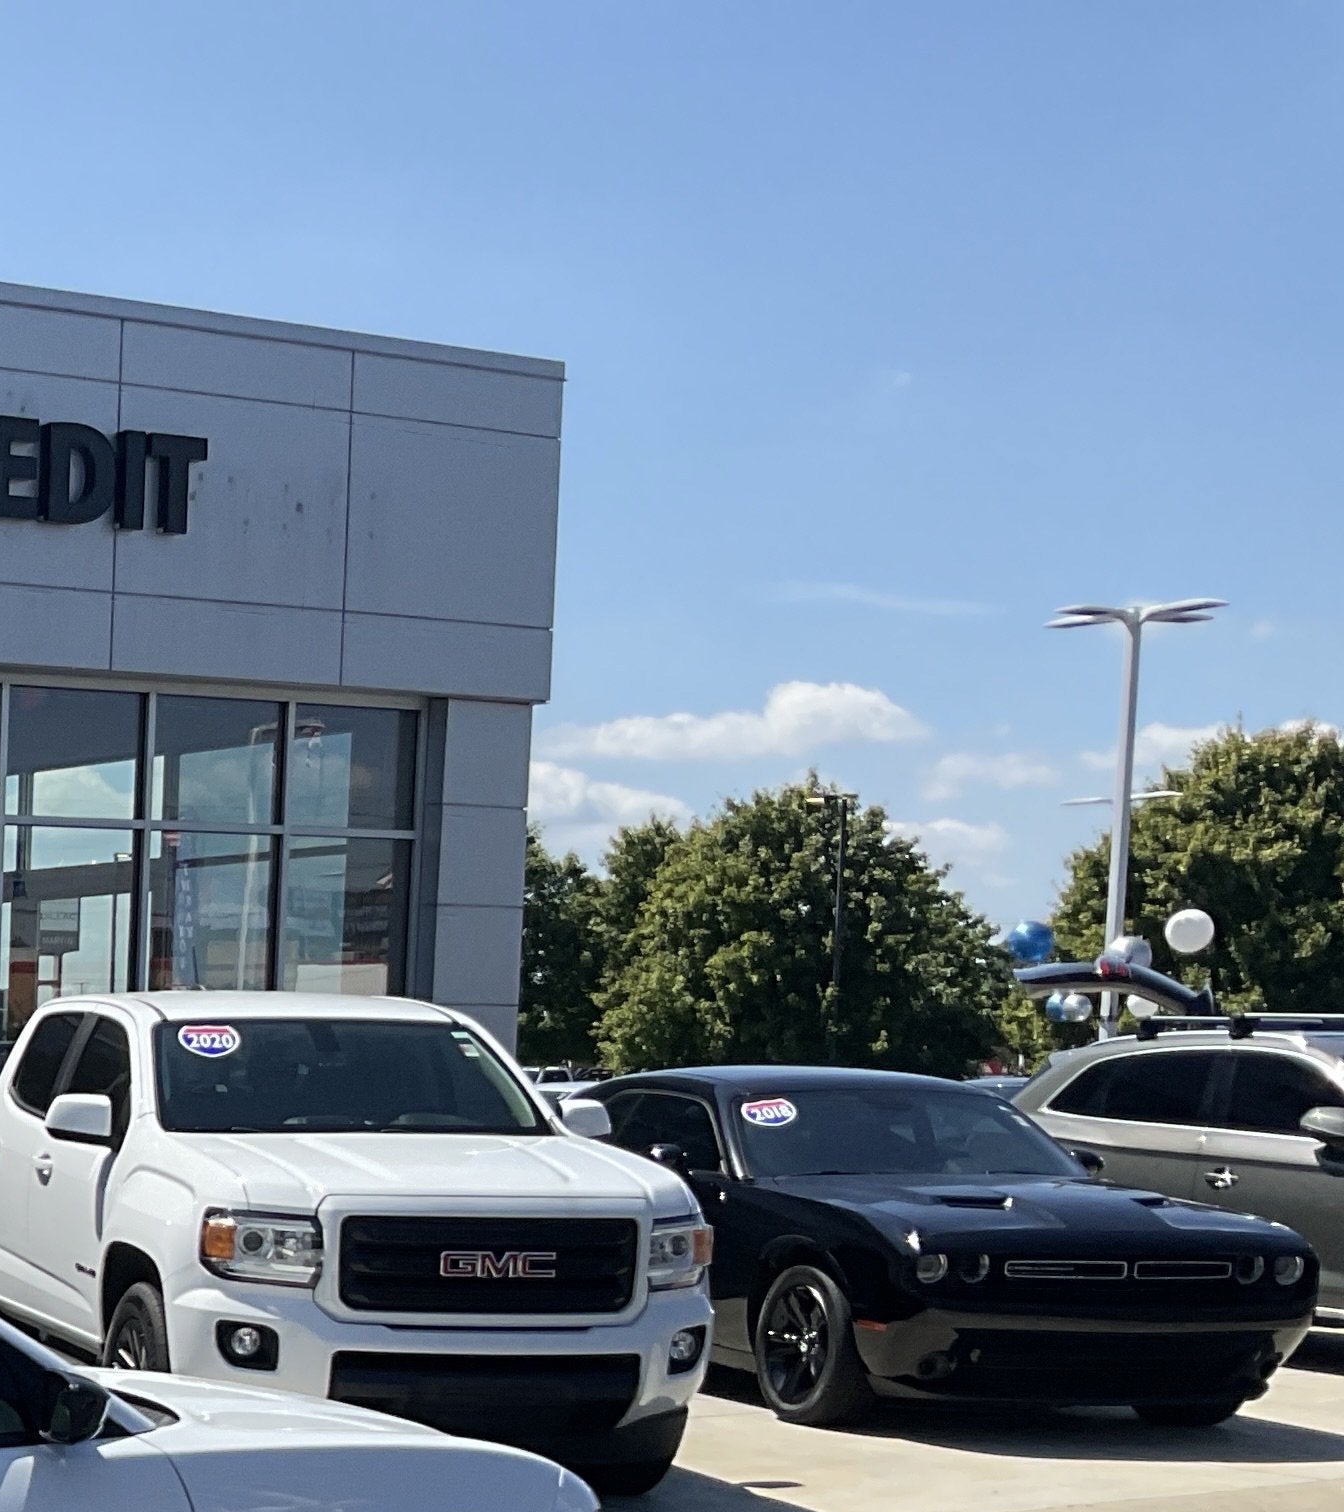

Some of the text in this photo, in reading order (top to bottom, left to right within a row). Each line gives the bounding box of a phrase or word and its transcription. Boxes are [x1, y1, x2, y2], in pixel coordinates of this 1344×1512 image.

[186, 1033, 234, 1049] 2020
[750, 1104, 793, 1121] 2018
[439, 1250, 557, 1278] GMC
